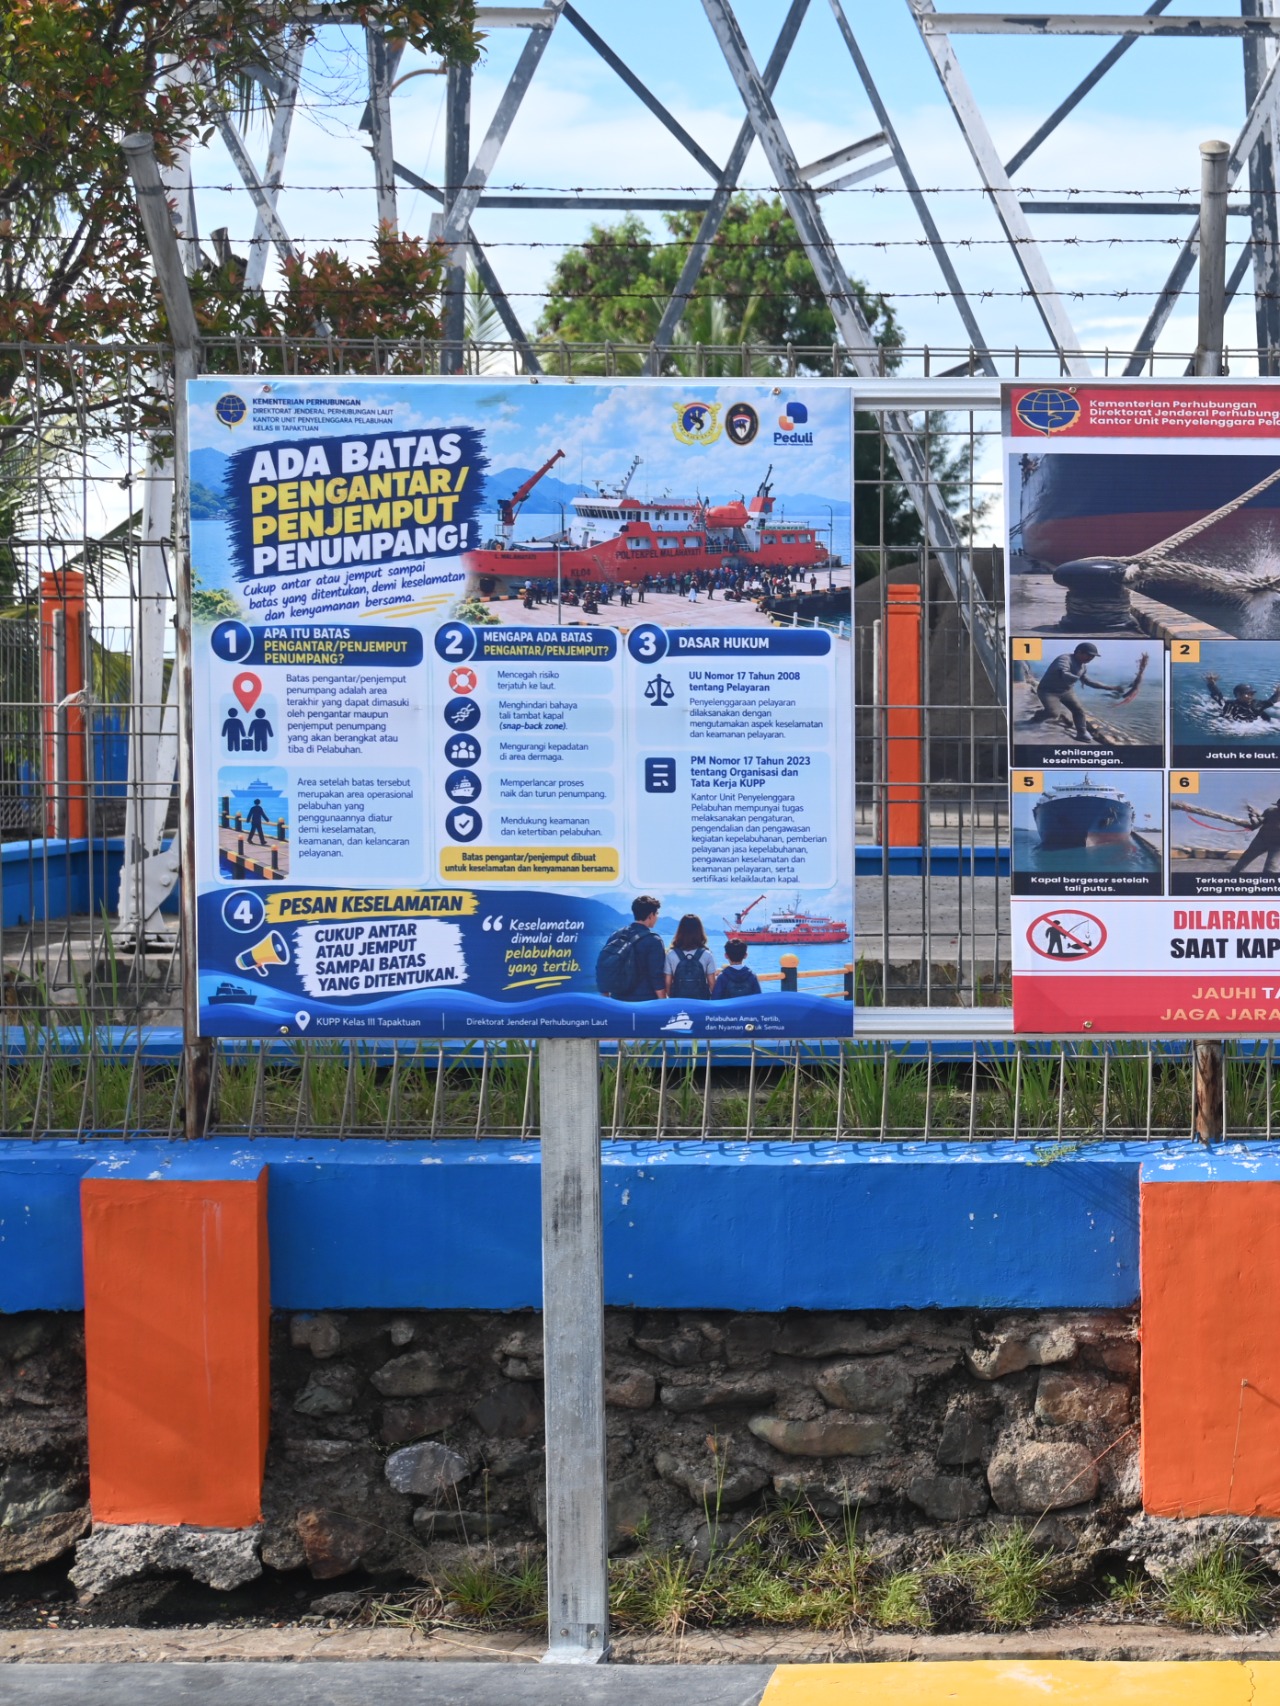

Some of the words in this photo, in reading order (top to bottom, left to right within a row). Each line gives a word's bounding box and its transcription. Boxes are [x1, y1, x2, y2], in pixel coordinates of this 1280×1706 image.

[252, 397, 304, 406] KEMENTERIAN
[306, 398, 361, 406] PERHUBUNGAN
[1089, 400, 1170, 408] Kementerian
[1172, 400, 1257, 411] Perhubungan
[253, 407, 292, 415] DIREKTORAT
[294, 407, 325, 415] JENDERAL
[327, 408, 375, 416] PERHUBUNGAN
[377, 408, 394, 416] LAUT
[1089, 408, 1152, 417] Direktorat
[1154, 409, 1210, 417] Jenderal
[253, 416, 279, 424] KANTOR
[281, 416, 296, 424] UNIT
[297, 416, 353, 425] PENYELENGGARA
[354, 417, 393, 425] PELABUHAN
[1089, 417, 1132, 426] Kantor
[1134, 417, 1160, 426] Unit
[1161, 417, 1256, 428] Penyelenggara
[253, 424, 273, 432] KELAS
[773, 432, 813, 444] Peduli
[248, 445, 331, 484] ADA
[342, 433, 461, 474] BATAS
[251, 466, 469, 514] PENGANTAR/
[252, 496, 459, 544] PENJEMPUT
[252, 522, 469, 575] PENUMPANG!
[243, 582, 276, 600] Cukup
[281, 576, 311, 590] antar
[316, 574, 340, 586] atau
[345, 569, 383, 585] jemput
[387, 562, 426, 579] sampai
[249, 595, 279, 610] batas
[282, 593, 307, 608] yang
[311, 584, 369, 602] ditentukan,
[371, 579, 397, 594] demi
[401, 572, 466, 591] keselamatan
[264, 607, 286, 621] dan
[290, 600, 361, 618] kenyamanan
[364, 593, 415, 609] bersama.
[264, 628, 288, 639] APA
[290, 628, 310, 639] ITU
[313, 628, 350, 639] BATAS
[483, 632, 533, 643] MENGAPA
[536, 632, 558, 643] ADA
[560, 632, 593, 643] BATAS
[224, 630, 236, 653] 1
[264, 640, 407, 653] PENGANTAR/PENJEMPUT
[445, 630, 464, 654] 2
[638, 631, 657, 656] 3
[678, 637, 720, 648] DASAR
[723, 637, 770, 649] HUKUM
[483, 645, 609, 656] PENGANTAR/PENJEMPUT?
[1023, 644, 1031, 654] 1
[1180, 645, 1191, 655] 2
[264, 652, 344, 664] PENUMPANG?
[286, 674, 310, 684] Batas
[312, 674, 407, 686] pengantar/penjemput
[689, 671, 702, 681] UU
[704, 672, 734, 681] Nomor
[737, 672, 746, 681] 17
[748, 672, 775, 681] Tahun
[777, 672, 801, 681] 2008
[286, 687, 336, 697] penumpang
[338, 686, 367, 695] adalah
[368, 687, 387, 695] area
[689, 683, 724, 694] tentang
[726, 683, 771, 694] Pelayaran
[1054, 748, 1114, 758] Kehilangan
[1205, 751, 1237, 760] Jatuh
[1239, 751, 1252, 760] ke
[1254, 751, 1279, 760] laut.
[1042, 756, 1124, 767] keseimbangan.
[1023, 777, 1034, 787] 5
[1179, 777, 1190, 788] 6
[278, 896, 338, 916] PESAN
[341, 895, 463, 913] KESELAMATAN
[233, 900, 253, 924] 4
[510, 918, 585, 931] Keselamatan
[1173, 910, 1280, 930] DILARANG
[314, 927, 365, 943] CUKUP
[368, 923, 417, 938] ANTAR
[511, 932, 553, 944] dimulai
[556, 932, 579, 944] dari
[315, 943, 355, 959] ATAU
[357, 938, 417, 956] JEMPUT
[505, 946, 572, 962] pelabuhan
[1170, 938, 1229, 959] SAAT
[315, 958, 377, 975] SAMPAI
[379, 953, 426, 969] BATAS
[508, 962, 537, 976] yang
[542, 960, 582, 972] tertib.
[318, 975, 360, 992] YANG
[363, 967, 459, 989] DITENTUKAN.
[1191, 987, 1257, 1000] JAUHI
[1160, 1008, 1220, 1021] JAGA
[316, 1017, 341, 1027] KUPP
[342, 1017, 366, 1027] Kelas
[367, 1017, 375, 1027] III
[377, 1017, 421, 1029] Tapaktuan
